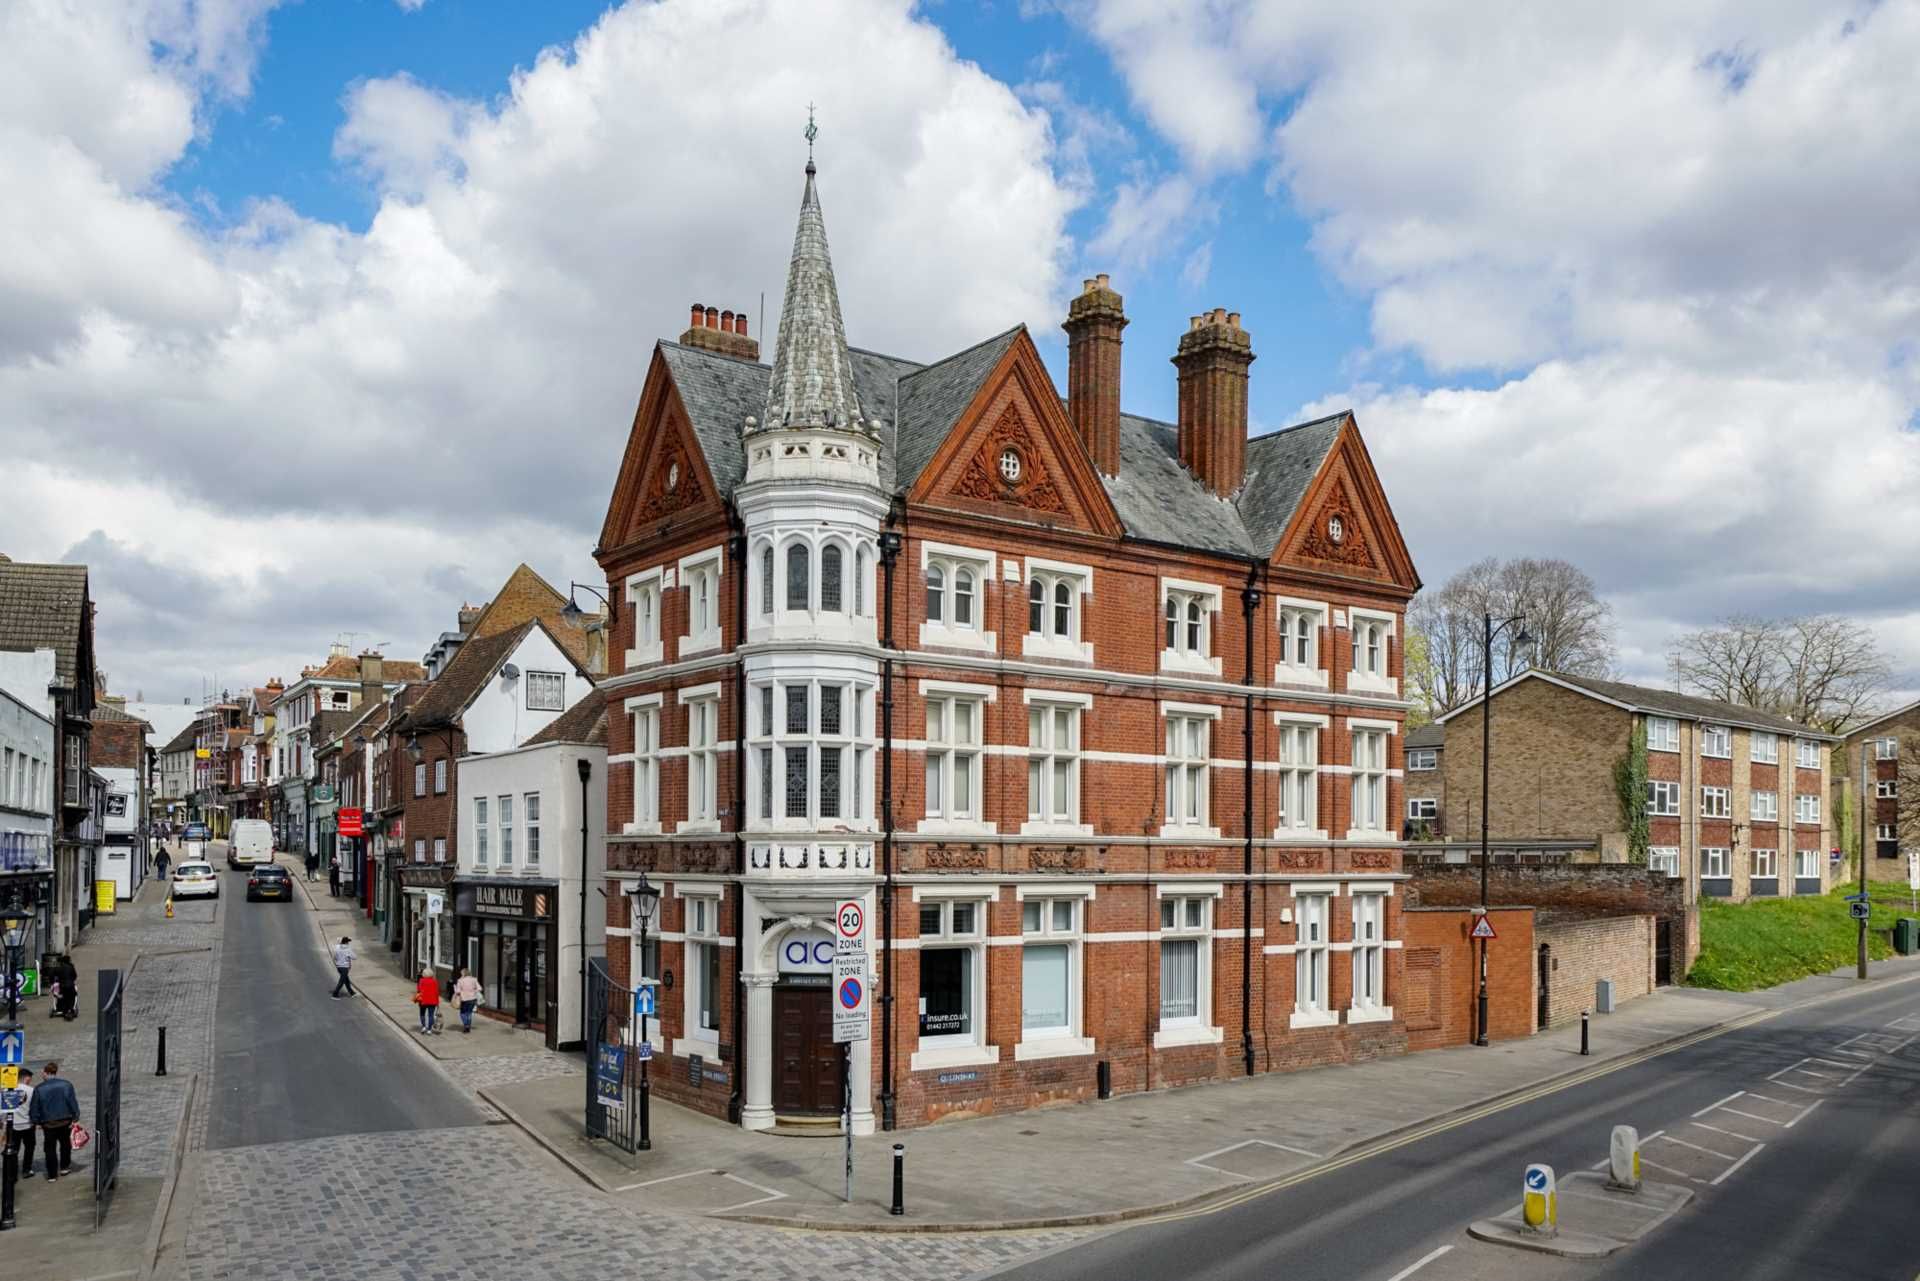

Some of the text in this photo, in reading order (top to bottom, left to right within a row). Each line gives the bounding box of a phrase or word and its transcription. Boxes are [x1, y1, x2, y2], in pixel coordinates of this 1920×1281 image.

[476, 886, 523, 906] HAIR MALE
[842, 912, 859, 928] 20
[839, 939, 862, 949] ZONE
[835, 957, 866, 966] Restricted
[839, 967, 861, 976] ZONE
[835, 1010, 866, 1020] No loading
